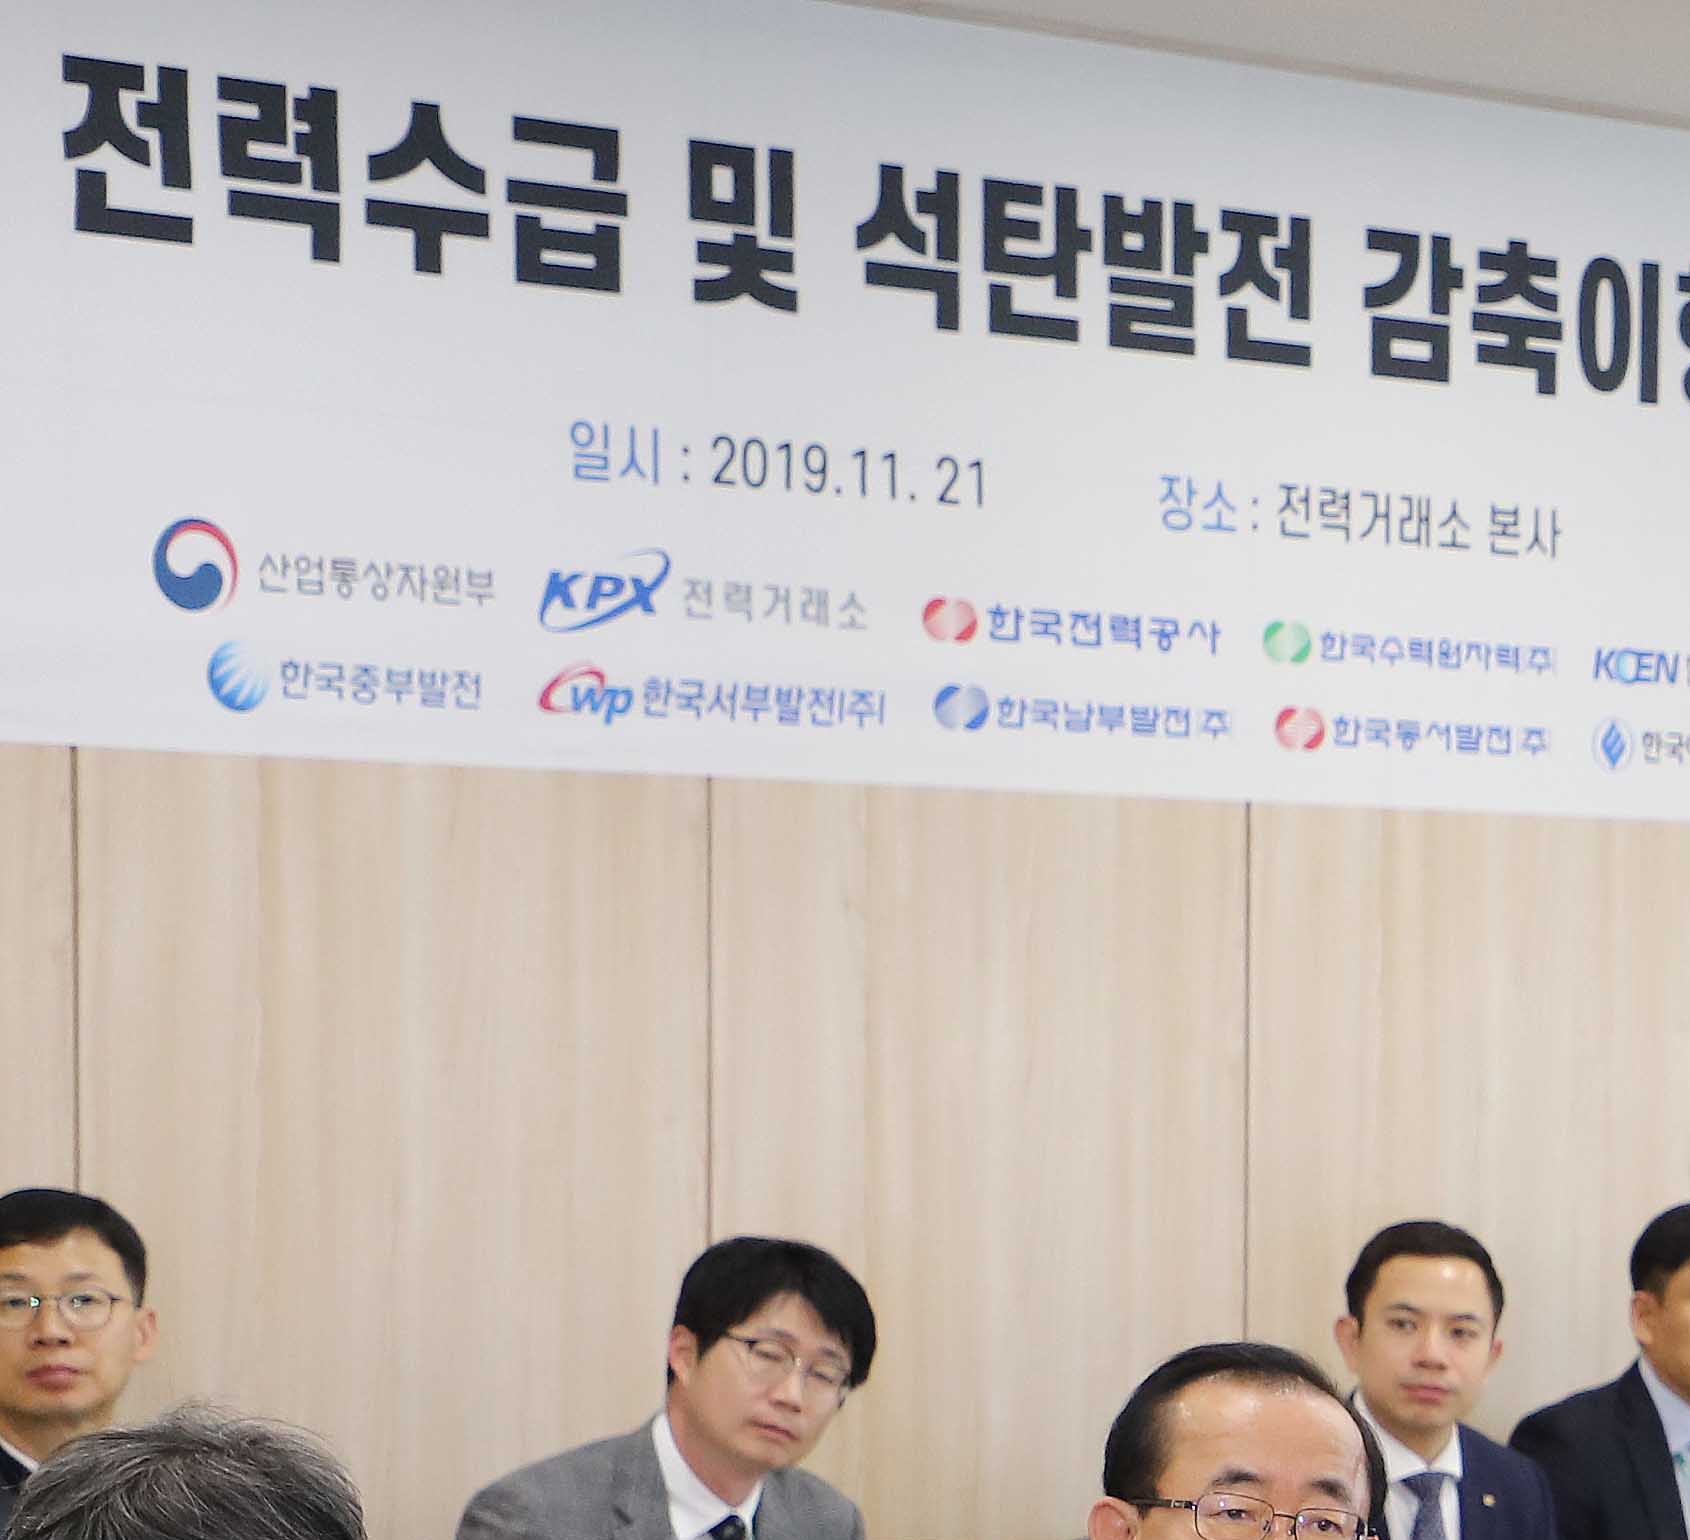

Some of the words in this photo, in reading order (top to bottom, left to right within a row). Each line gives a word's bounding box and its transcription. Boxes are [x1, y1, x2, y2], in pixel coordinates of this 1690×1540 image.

[61, 52, 629, 294] 전력수급
[687, 137, 799, 314] 및
[855, 161, 1313, 369] 석탄발전
[1276, 482, 1472, 552] 전력거래소
[1487, 502, 1563, 560] 본사
[258, 552, 496, 608] 산업통상자원부
[538, 555, 672, 629] KPX
[683, 577, 868, 630] 전력거래소
[985, 601, 1223, 657] 한국전력공사
[279, 658, 483, 711] 한국중부발전
